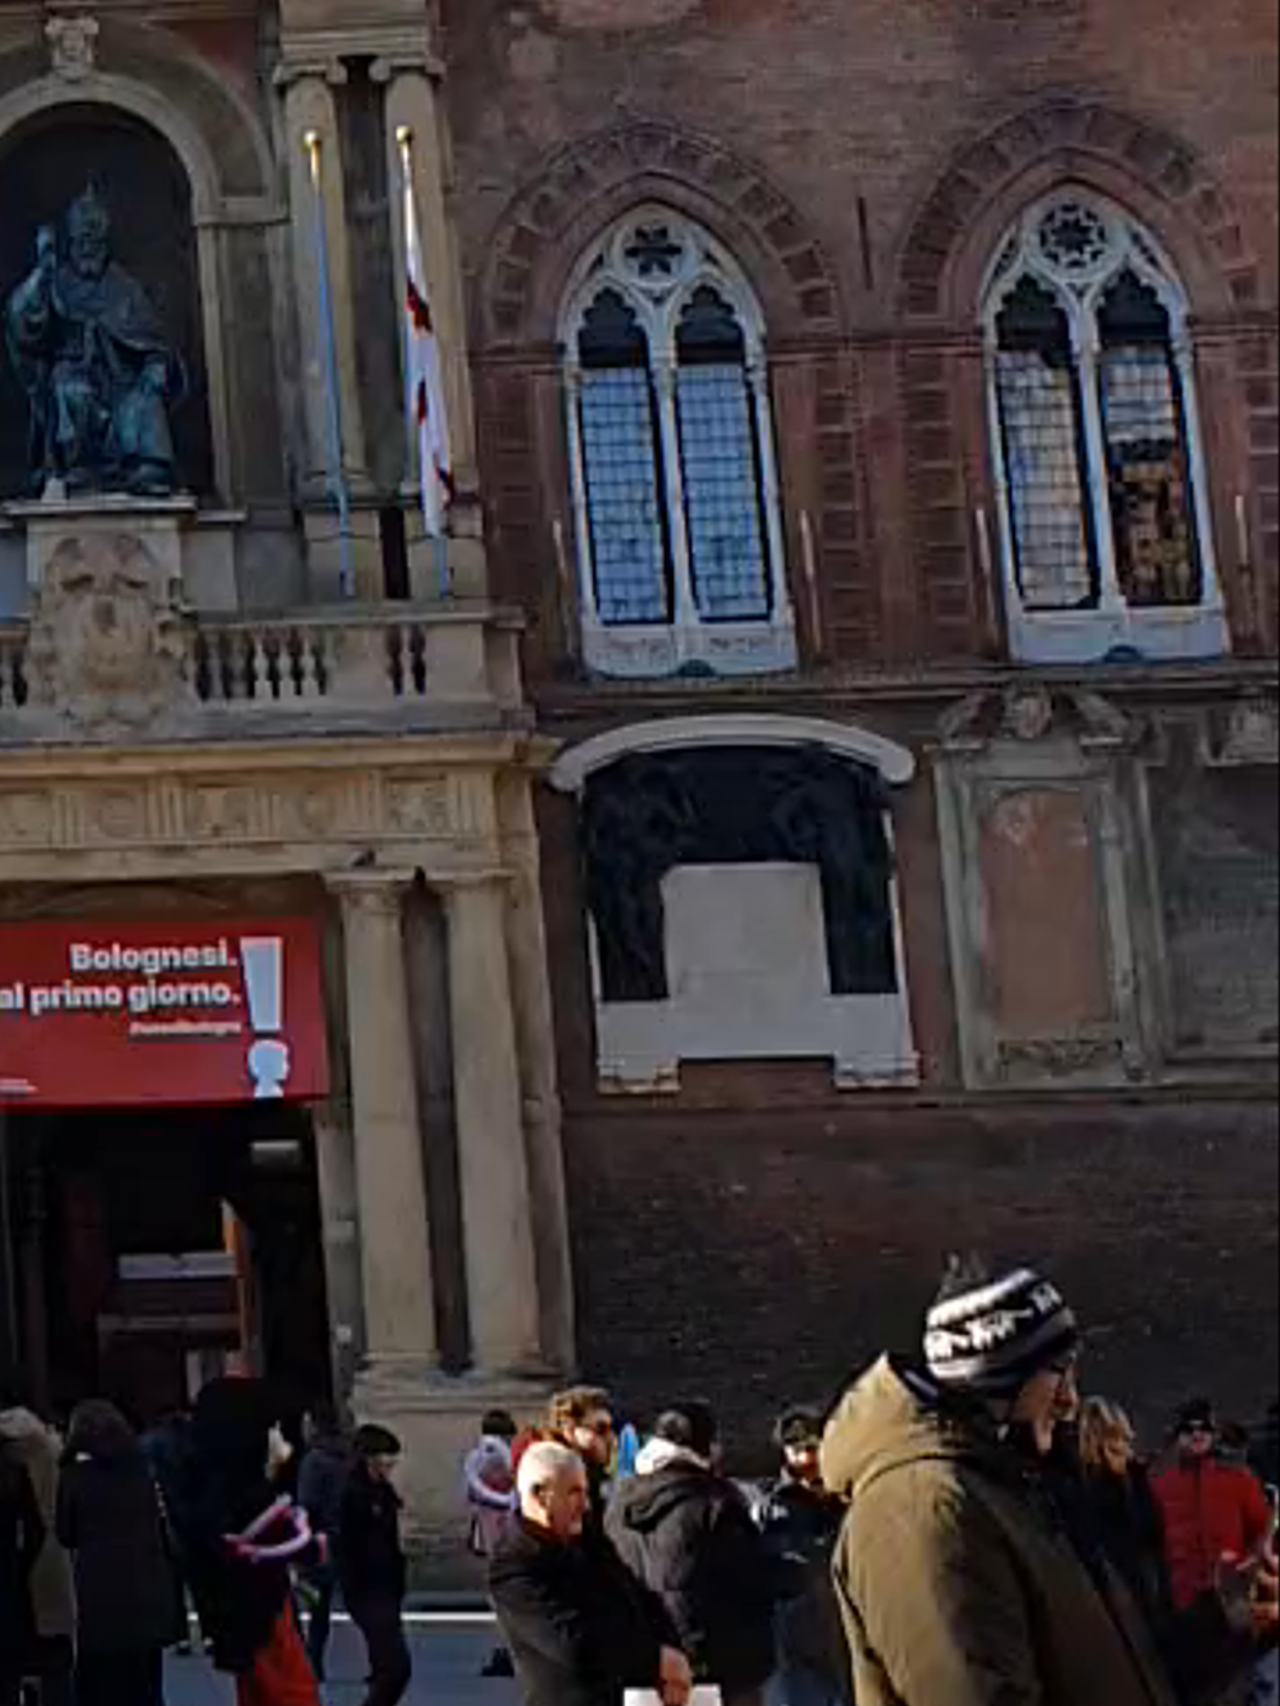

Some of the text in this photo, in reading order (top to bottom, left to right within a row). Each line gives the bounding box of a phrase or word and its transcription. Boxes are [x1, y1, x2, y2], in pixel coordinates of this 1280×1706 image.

[69, 937, 238, 973] Bolognesi.
[29, 979, 124, 1016] primo
[127, 976, 242, 1013] giorno.
